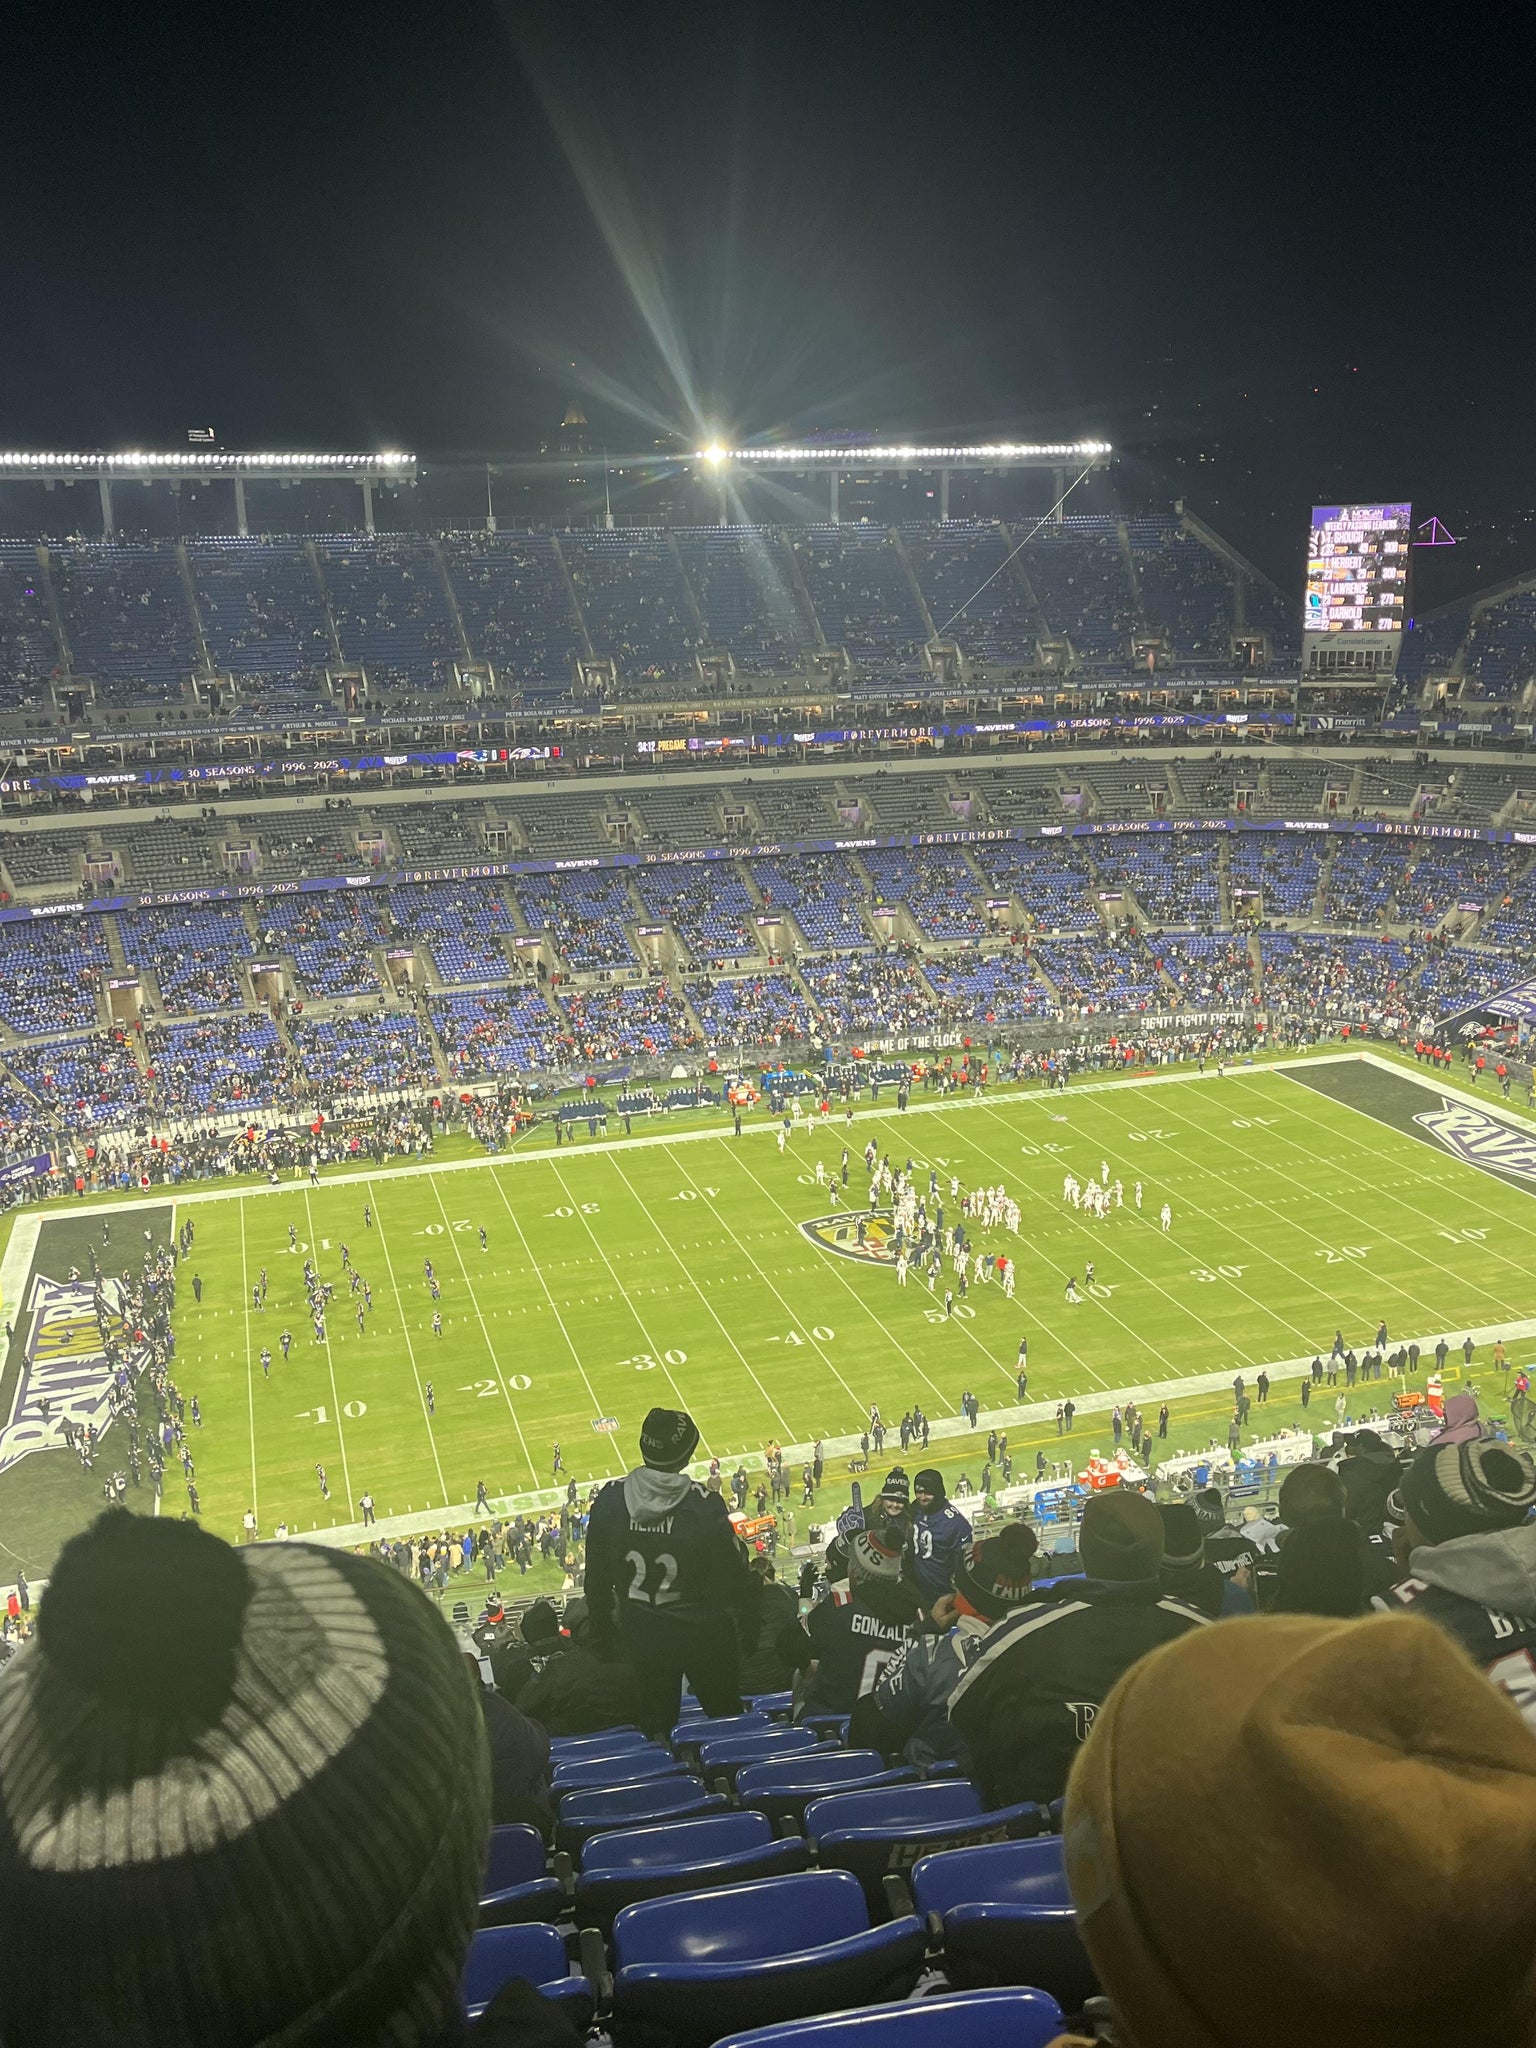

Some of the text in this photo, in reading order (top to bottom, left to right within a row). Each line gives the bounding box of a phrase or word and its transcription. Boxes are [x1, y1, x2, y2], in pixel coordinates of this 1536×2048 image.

[1352, 509, 1384, 517] MORGAN
[1330, 582, 1369, 595] LAWRENCE
[1329, 607, 1362, 619] DARNOLD
[1337, 638, 1384, 646] Constellation
[724, 701, 743, 709] LEWIS
[523, 709, 554, 717] BOULWARE
[282, 721, 307, 730] ARTHUR
[314, 720, 339, 729] MODELL
[381, 716, 406, 725] MICHAEL
[1055, 720, 1067, 729] 30
[1070, 718, 1112, 728] SEASONS
[1334, 718, 1366, 728] merritt
[843, 726, 935, 741] FOREVERMORE
[975, 723, 1016, 733] RAVENS
[657, 739, 687, 752] PREGAME
[187, 769, 200, 779] 30
[205, 766, 256, 778] SEASONS
[85, 774, 138, 786] RAVENS
[1092, 824, 1103, 833] 30
[1106, 822, 1151, 833] SEASONS
[1283, 821, 1331, 830] RAVENS
[1376, 822, 1481, 840] FOREVERMORE
[918, 829, 1013, 845] FOREVERMORE
[835, 839, 877, 849] RAVENS
[645, 853, 657, 864] 30
[661, 850, 706, 863] SEASONS
[554, 858, 600, 870] RAVENS
[403, 864, 510, 882] FOREVERMORE
[138, 896, 152, 906] 30
[157, 890, 211, 905] SEASONS
[30, 903, 84, 916] RAVENS
[1140, 1016, 1173, 1030] FIGHT!
[1175, 1013, 1208, 1028] FIGHT!
[897, 1037, 911, 1051] OF
[911, 1035, 931, 1049] THE
[932, 1033, 963, 1048] FLOCK
[1436, 1227, 1486, 1247] 10
[1314, 1244, 1368, 1265] 20
[1190, 1263, 1244, 1285] 30
[923, 1303, 978, 1324] 50
[784, 1325, 836, 1346] 40
[631, 1347, 687, 1373] 30
[474, 1373, 533, 1398] 20
[312, 1400, 368, 1425] 10
[625, 1550, 682, 1606] 22
[851, 1613, 913, 1642] GONZALE
